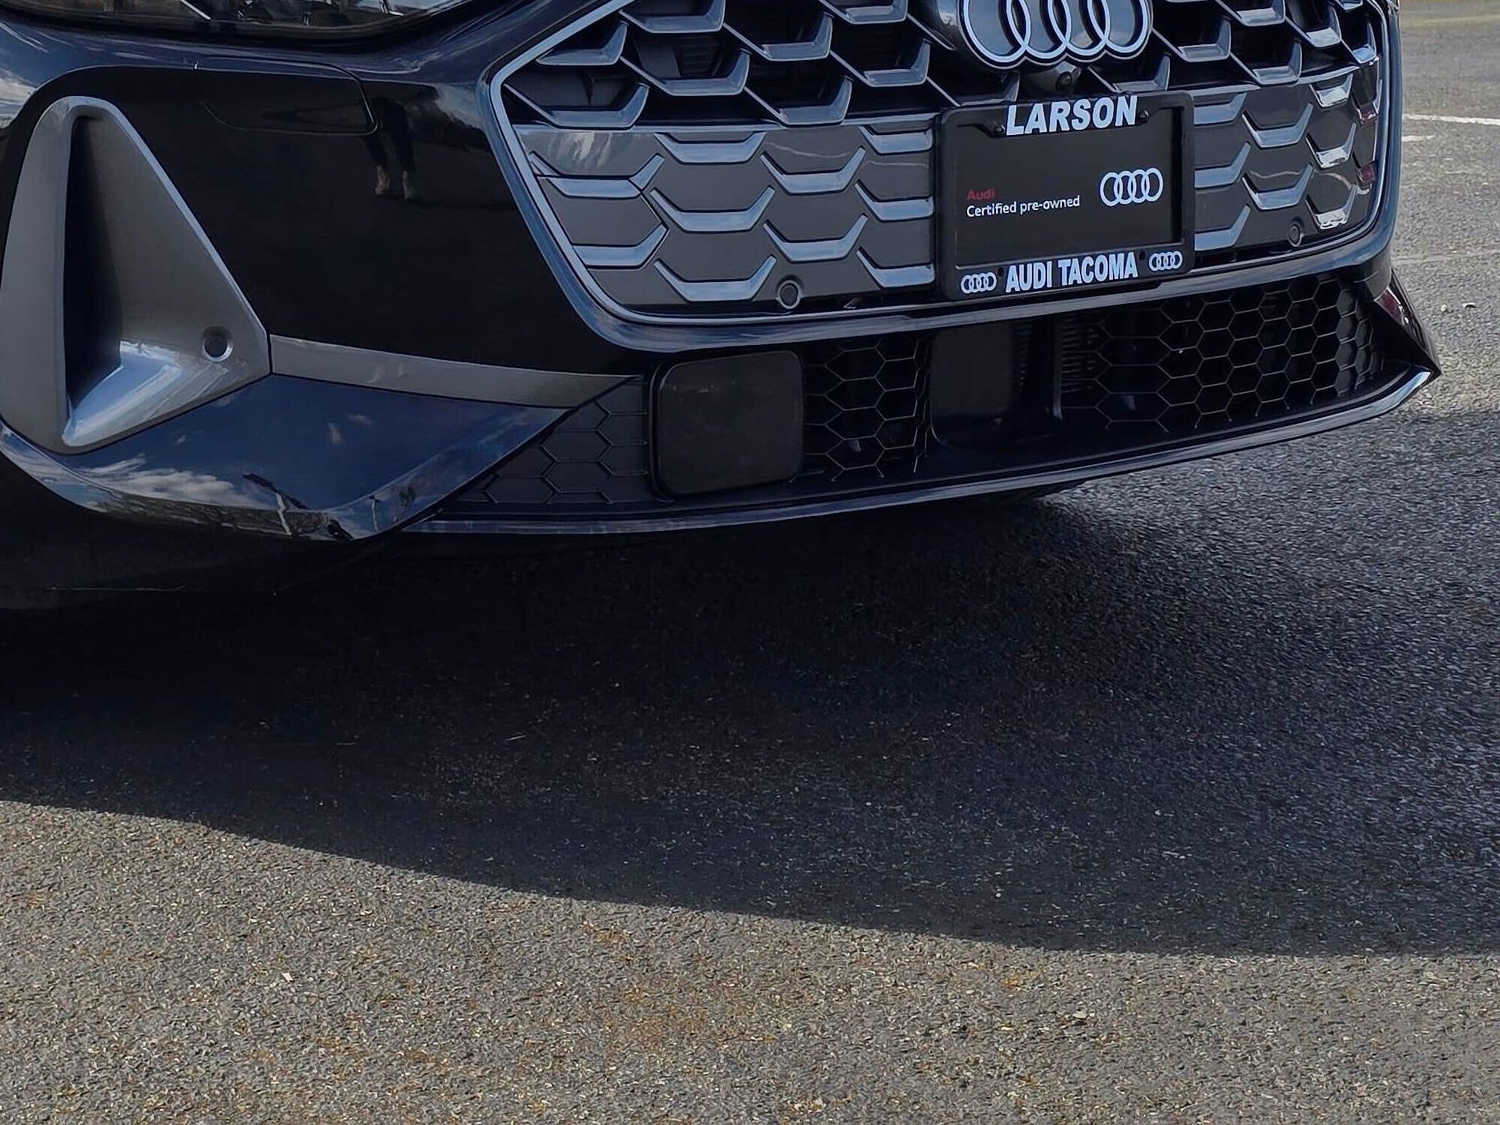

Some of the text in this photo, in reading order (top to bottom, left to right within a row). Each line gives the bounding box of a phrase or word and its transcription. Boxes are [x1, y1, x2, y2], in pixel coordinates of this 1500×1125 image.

[1006, 95, 1138, 136] LARSON
[966, 195, 1080, 217] Certified pre-owned
[967, 188, 995, 202] Audi
[1006, 252, 1138, 293] AUDI TACOMA
